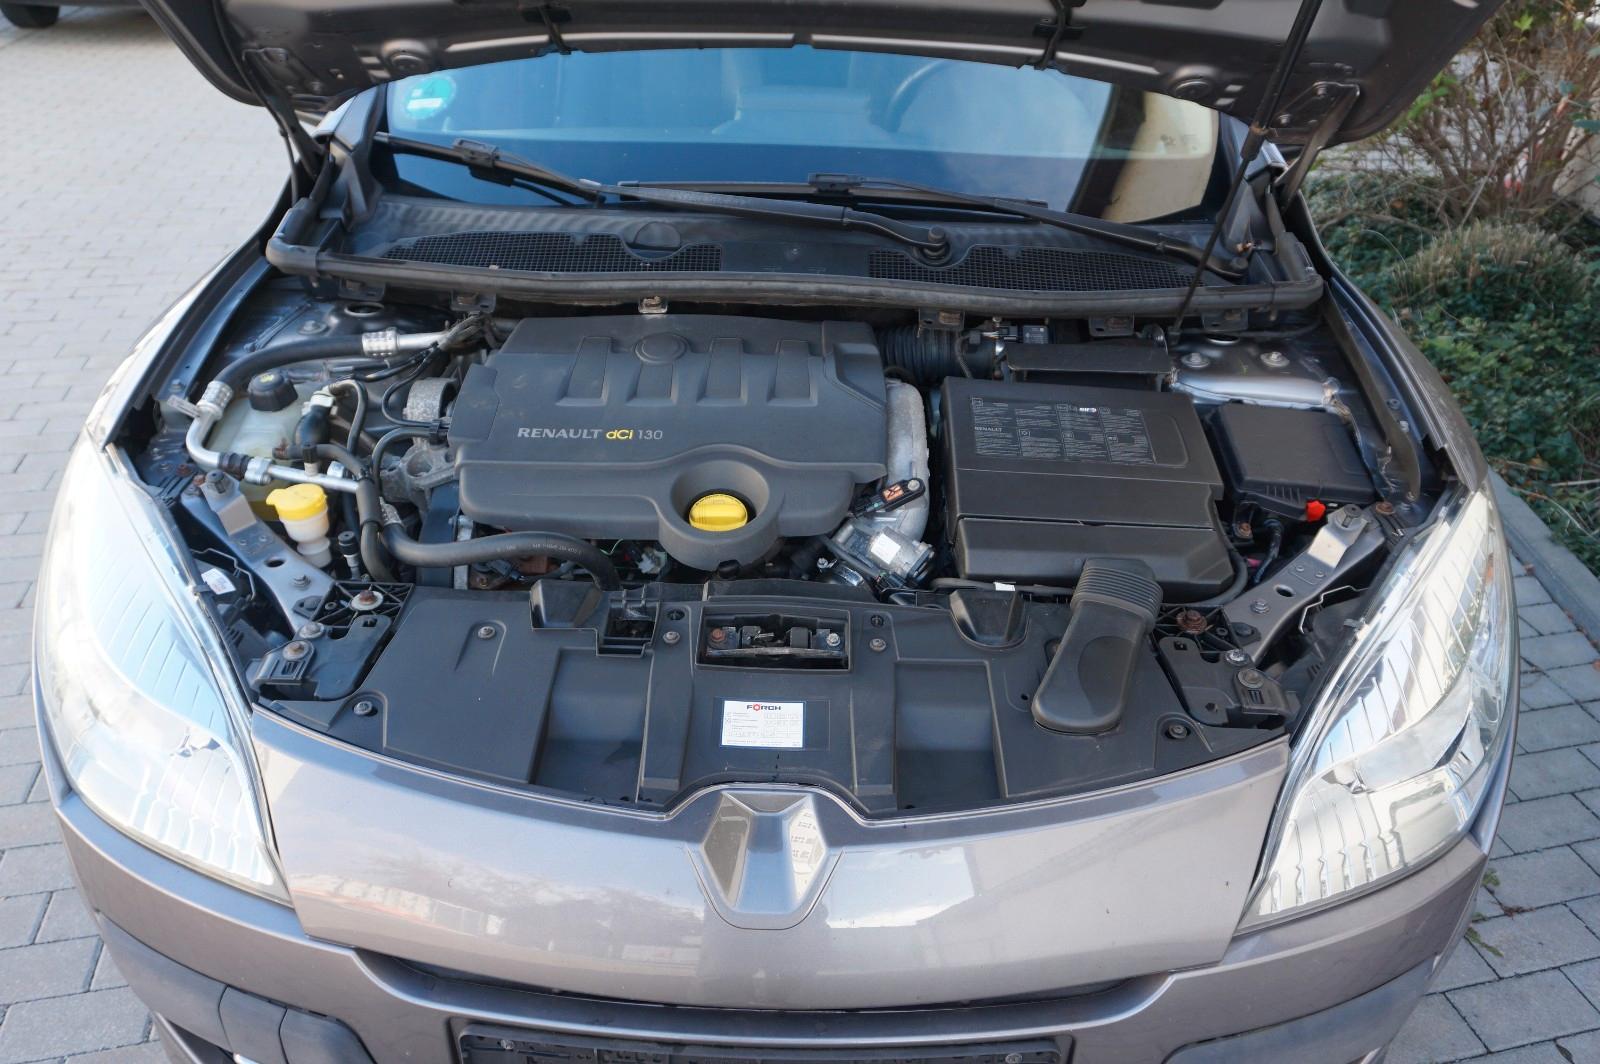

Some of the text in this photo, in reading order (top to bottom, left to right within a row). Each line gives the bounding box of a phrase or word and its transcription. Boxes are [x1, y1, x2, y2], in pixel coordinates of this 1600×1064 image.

[517, 427, 663, 440] RENAULT dCi 130
